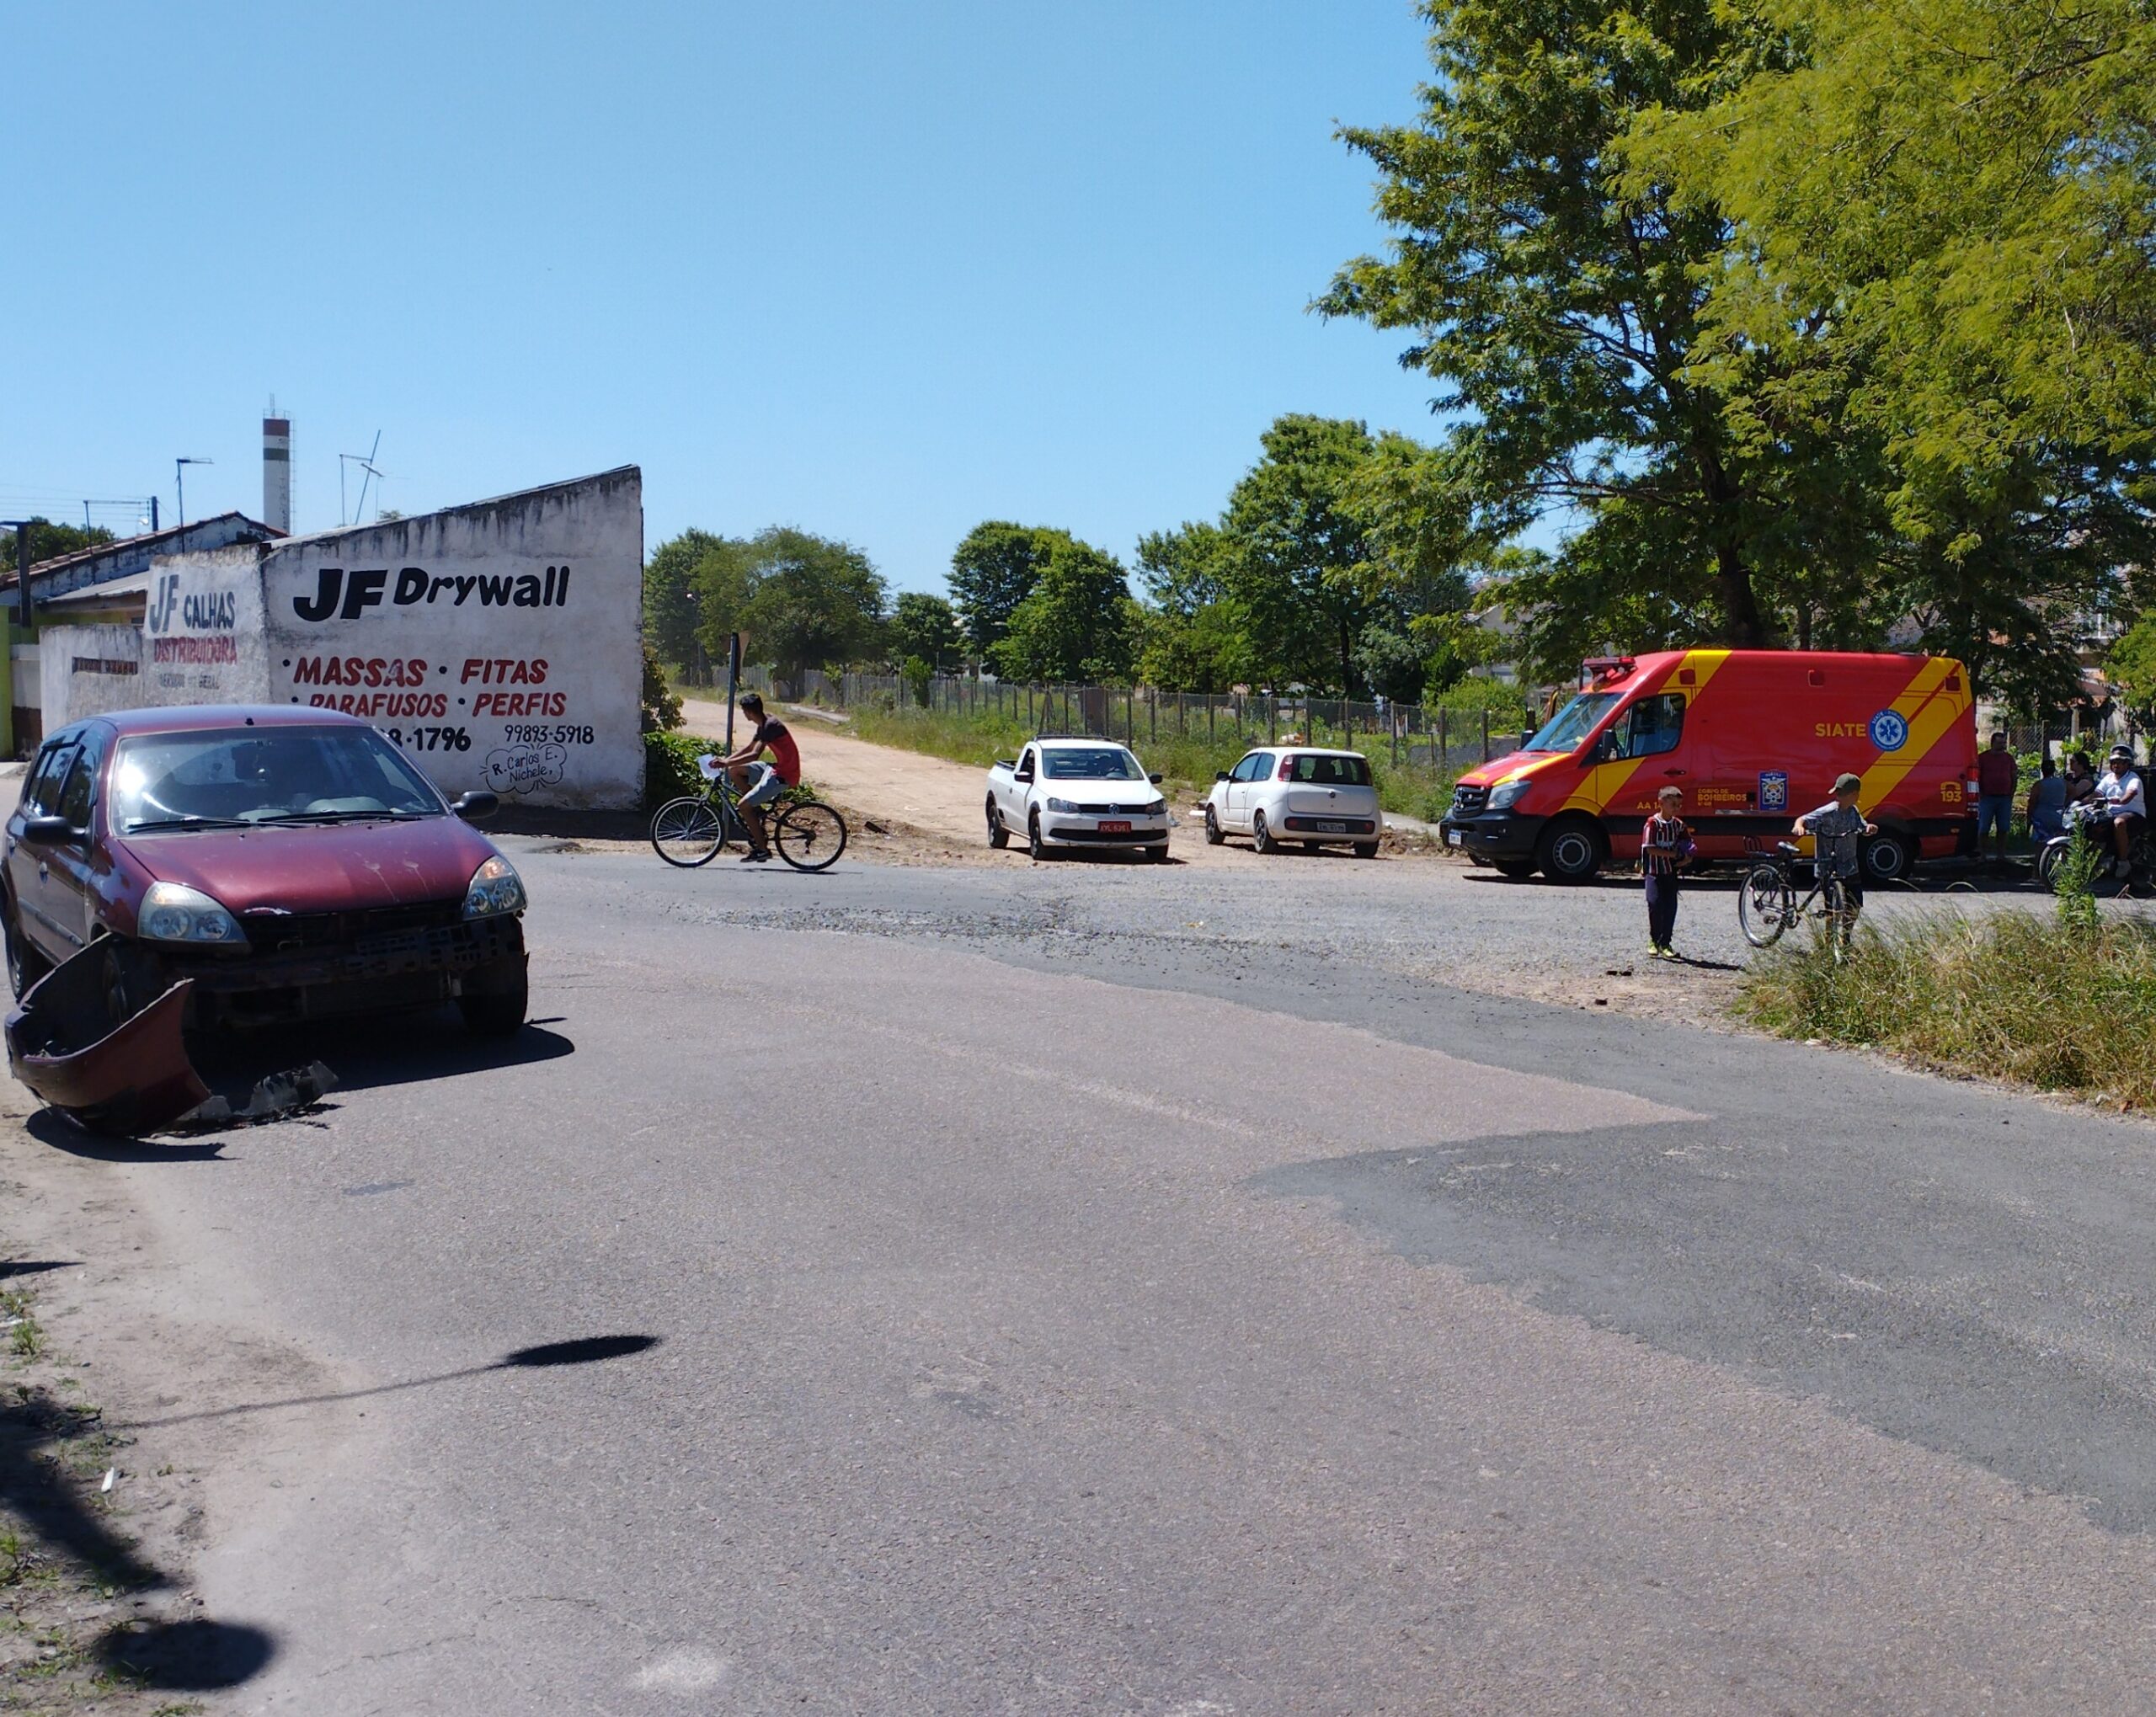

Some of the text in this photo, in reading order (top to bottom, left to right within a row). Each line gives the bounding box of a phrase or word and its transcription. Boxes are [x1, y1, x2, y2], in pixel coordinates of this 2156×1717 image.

[149, 574, 235, 632] JF CALHAS
[293, 565, 570, 621] JF Drywall
[154, 635, 237, 664] DISTRIBUIDORA
[293, 657, 548, 687] MASSAS FITAS
[309, 692, 567, 717] PARAFUSOS PERFIS
[1815, 723, 1866, 738] SIATE
[507, 752, 539, 770] Carlos
[1698, 793, 1747, 802] BOMBEIROS
[1940, 791, 1962, 803] 193
